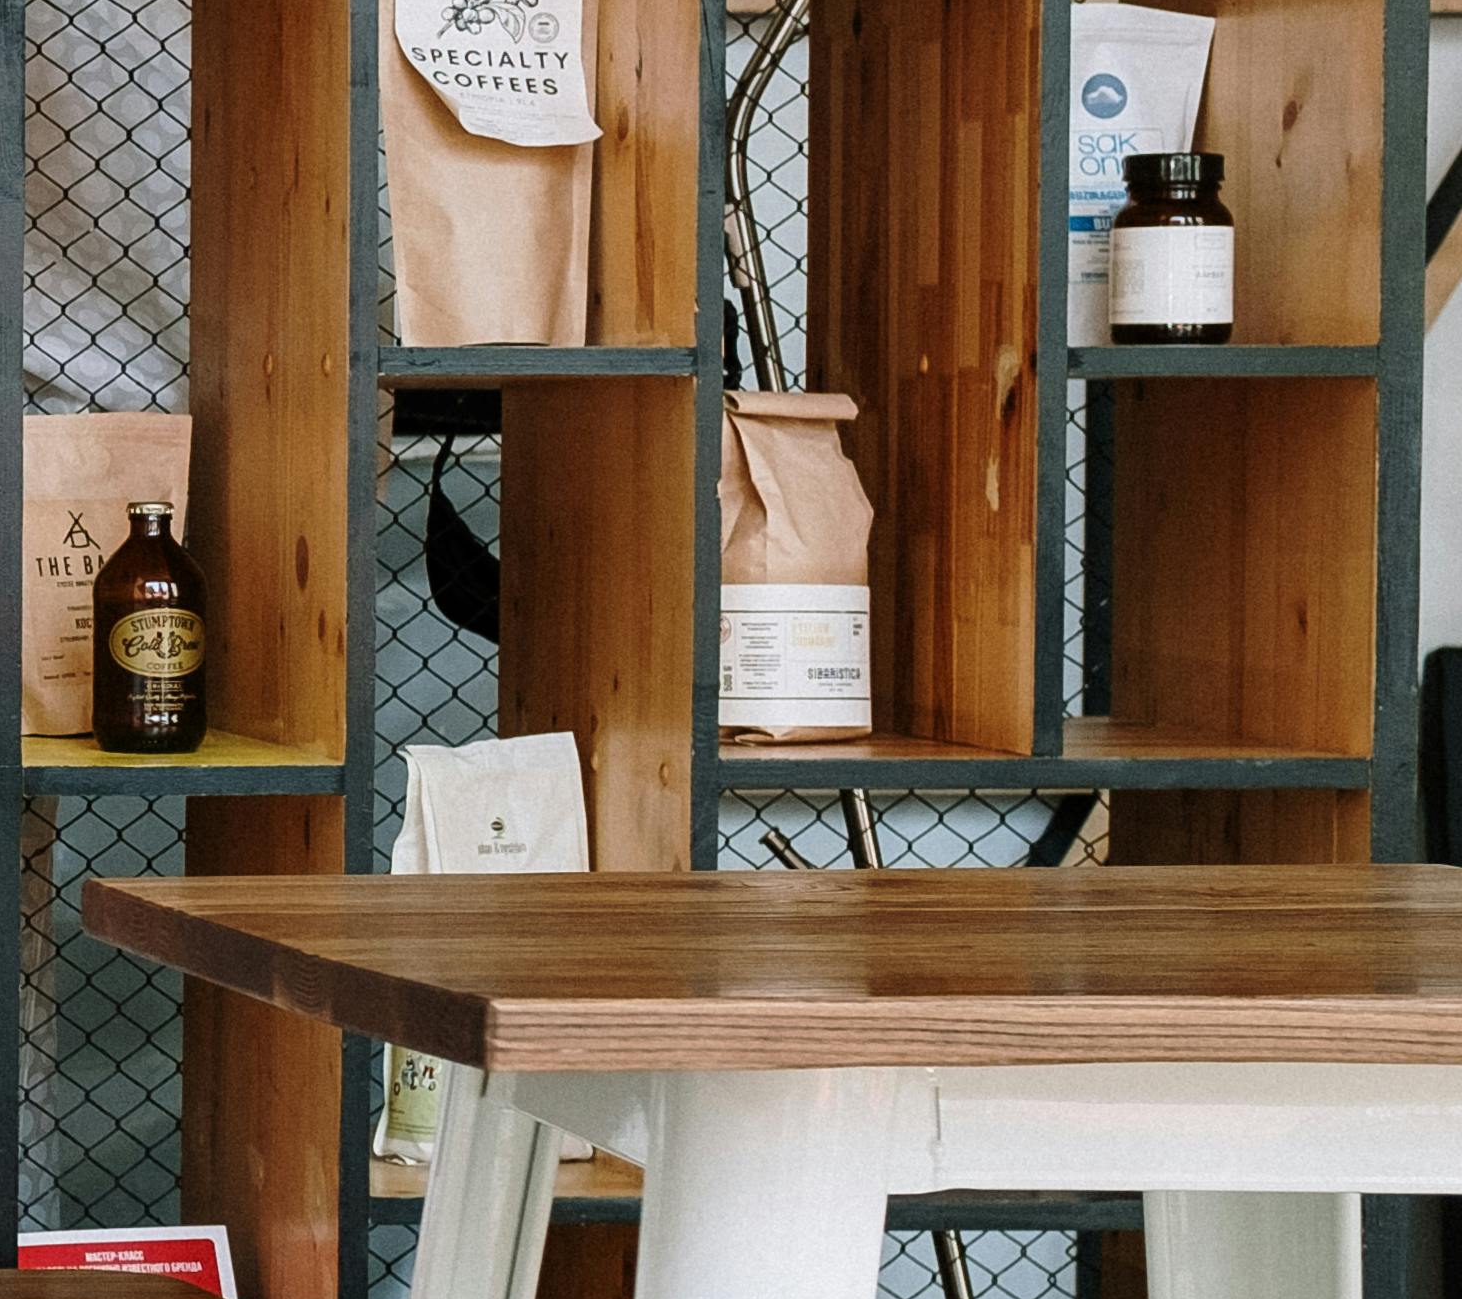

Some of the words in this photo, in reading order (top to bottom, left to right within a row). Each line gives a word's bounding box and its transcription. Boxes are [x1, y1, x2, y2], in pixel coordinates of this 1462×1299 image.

[412, 46, 569, 70] SPECIALTY
[433, 70, 559, 96] COFFEES
[1078, 132, 1138, 154] sak
[35, 557, 72, 578] THE
[130, 615, 195, 632] STUMPTOWN
[146, 661, 184, 671] COFFEE
[85, 1251, 144, 1262] МАСТЕР-КЛАСС
[171, 1262, 202, 1272] БРЕНДА
